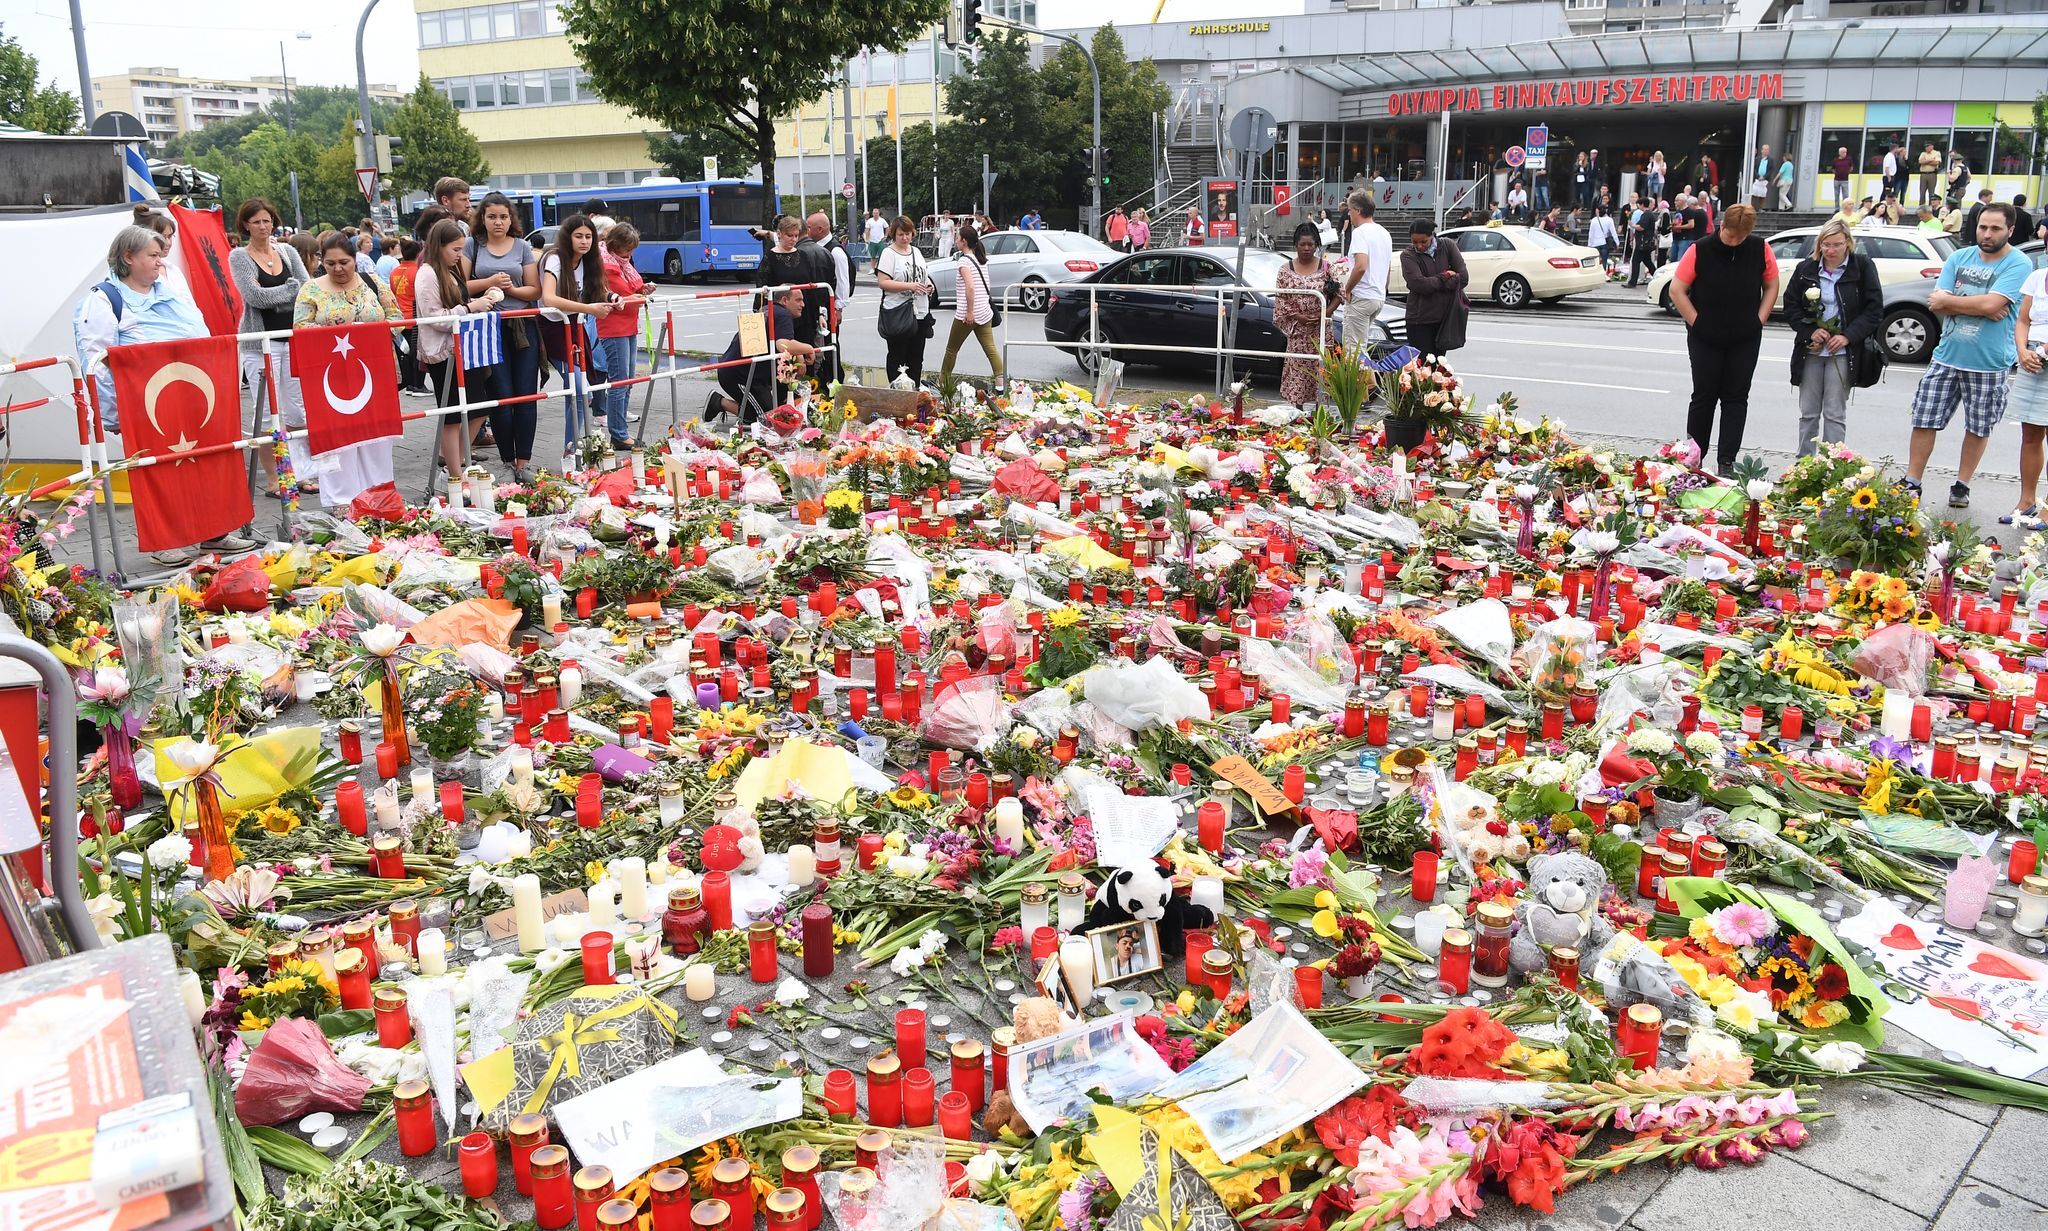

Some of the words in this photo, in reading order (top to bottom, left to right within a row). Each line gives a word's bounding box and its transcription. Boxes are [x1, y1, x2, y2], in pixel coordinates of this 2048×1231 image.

[1188, 22, 1270, 36] FAHRSCHULE
[1387, 87, 1481, 116] OLYMPIA
[1492, 73, 1784, 109] EINKAUFSZENTRUM
[1527, 147, 1545, 155] TAXI
[118, 1171, 178, 1200] CABINET
